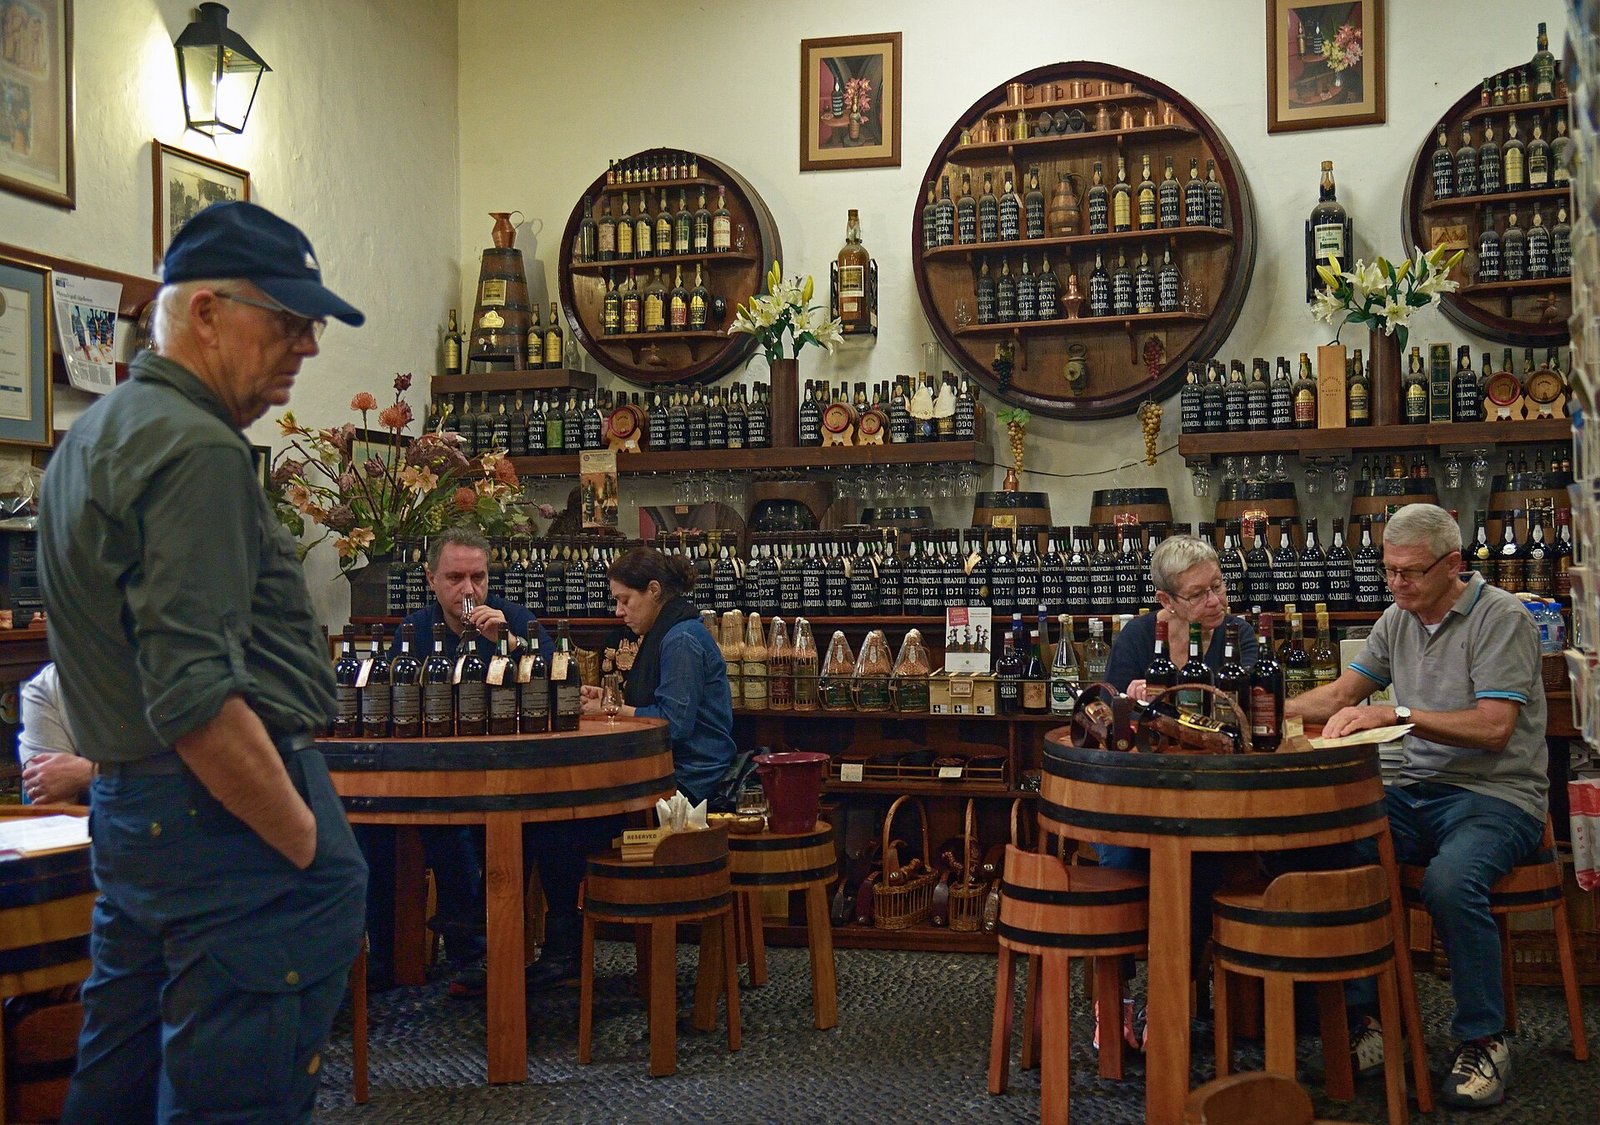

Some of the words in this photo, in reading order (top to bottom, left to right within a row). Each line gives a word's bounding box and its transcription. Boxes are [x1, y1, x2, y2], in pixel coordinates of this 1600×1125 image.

[1043, 586, 1063, 594] 1980
[1093, 585, 1112, 593] 1981
[1118, 584, 1137, 592] 1982
[1276, 582, 1296, 590] 1990
[1017, 587, 1037, 595] 1978
[627, 833, 657, 841] RESERVED
